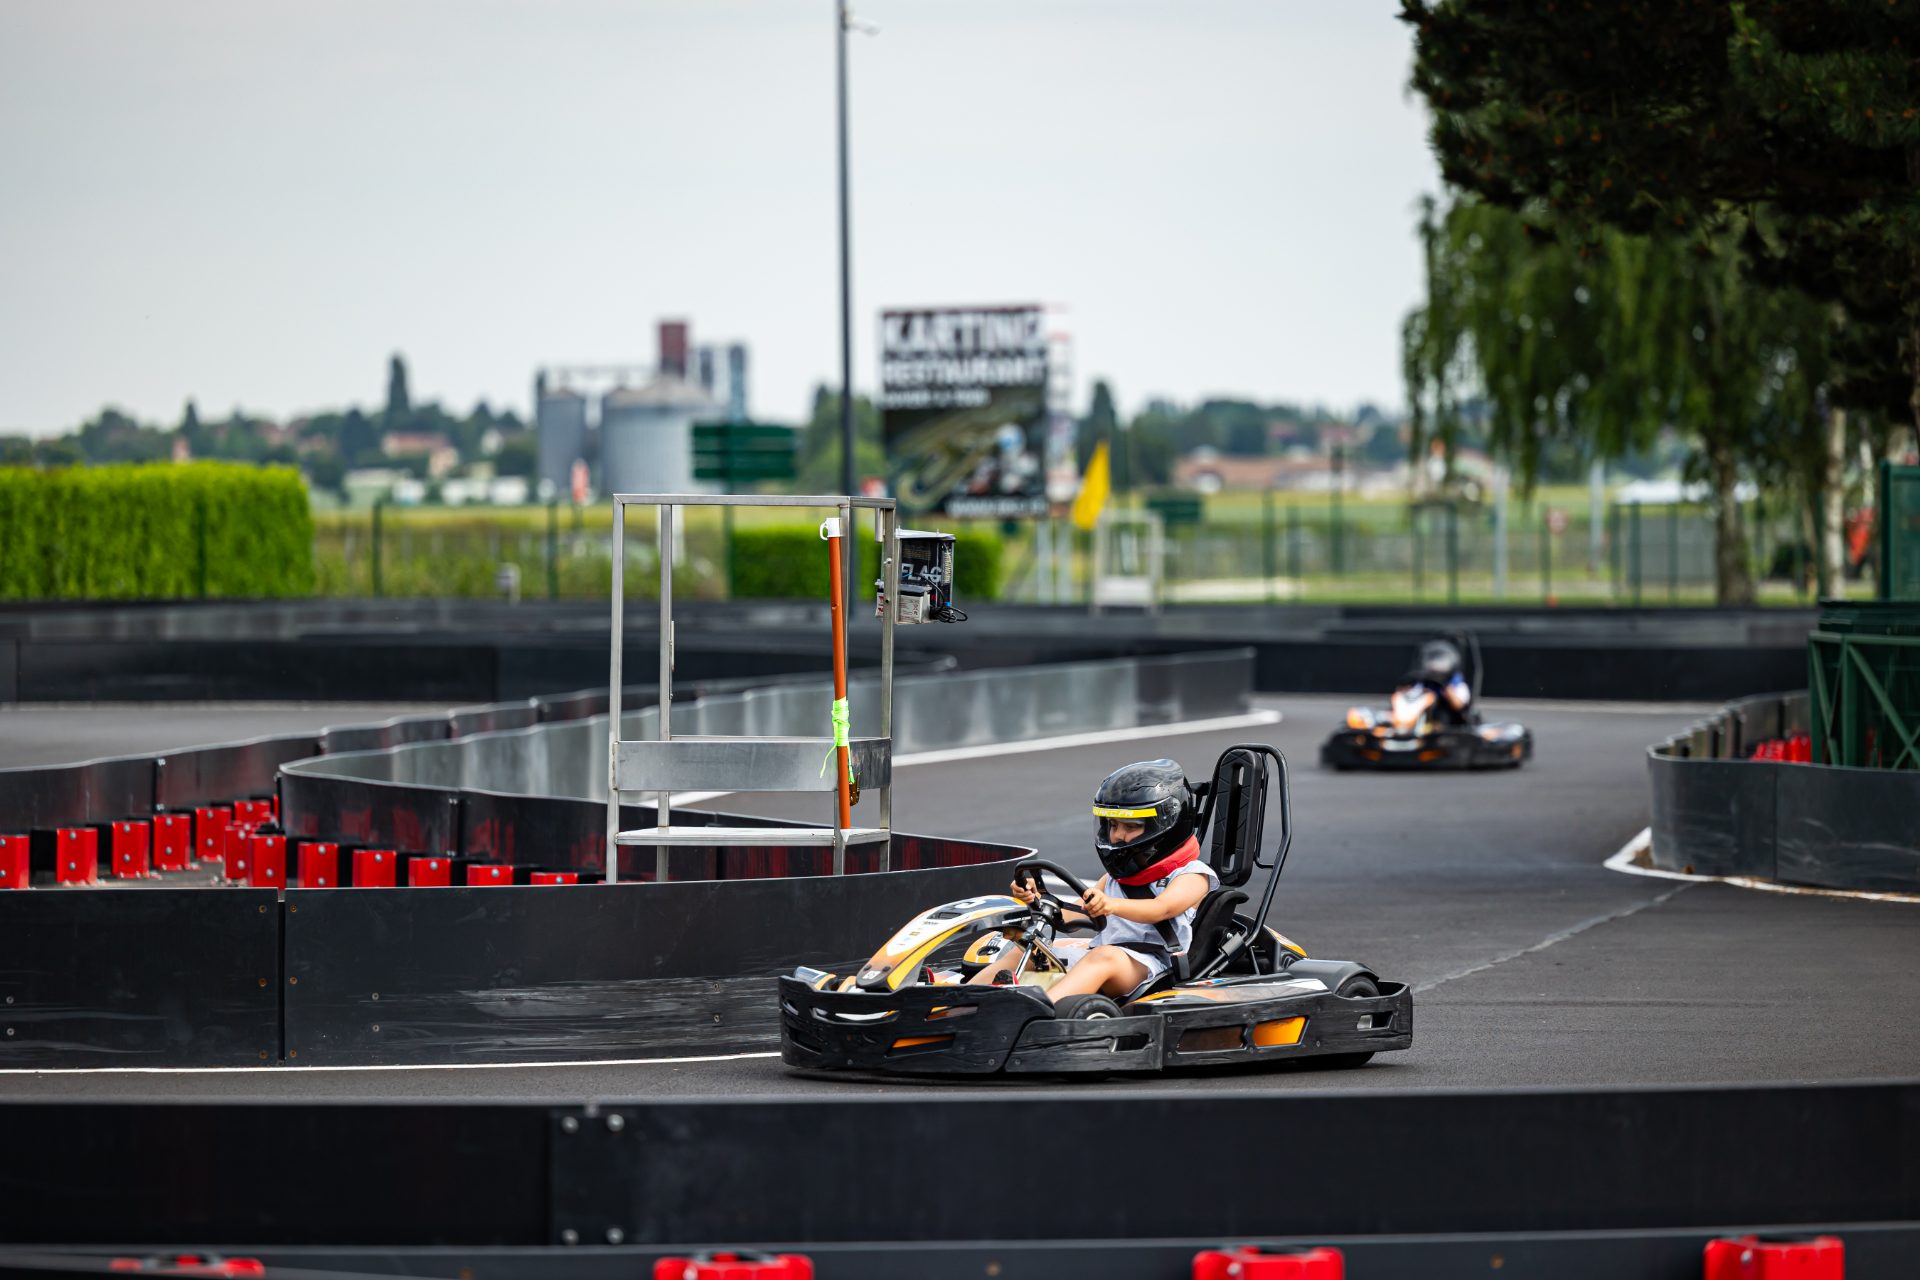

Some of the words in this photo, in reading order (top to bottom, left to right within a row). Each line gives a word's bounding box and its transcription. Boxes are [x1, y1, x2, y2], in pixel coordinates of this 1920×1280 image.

[882, 312, 1042, 351] KARTING
[883, 358, 1046, 387] RESTAURANT
[901, 562, 942, 583] FLAG
